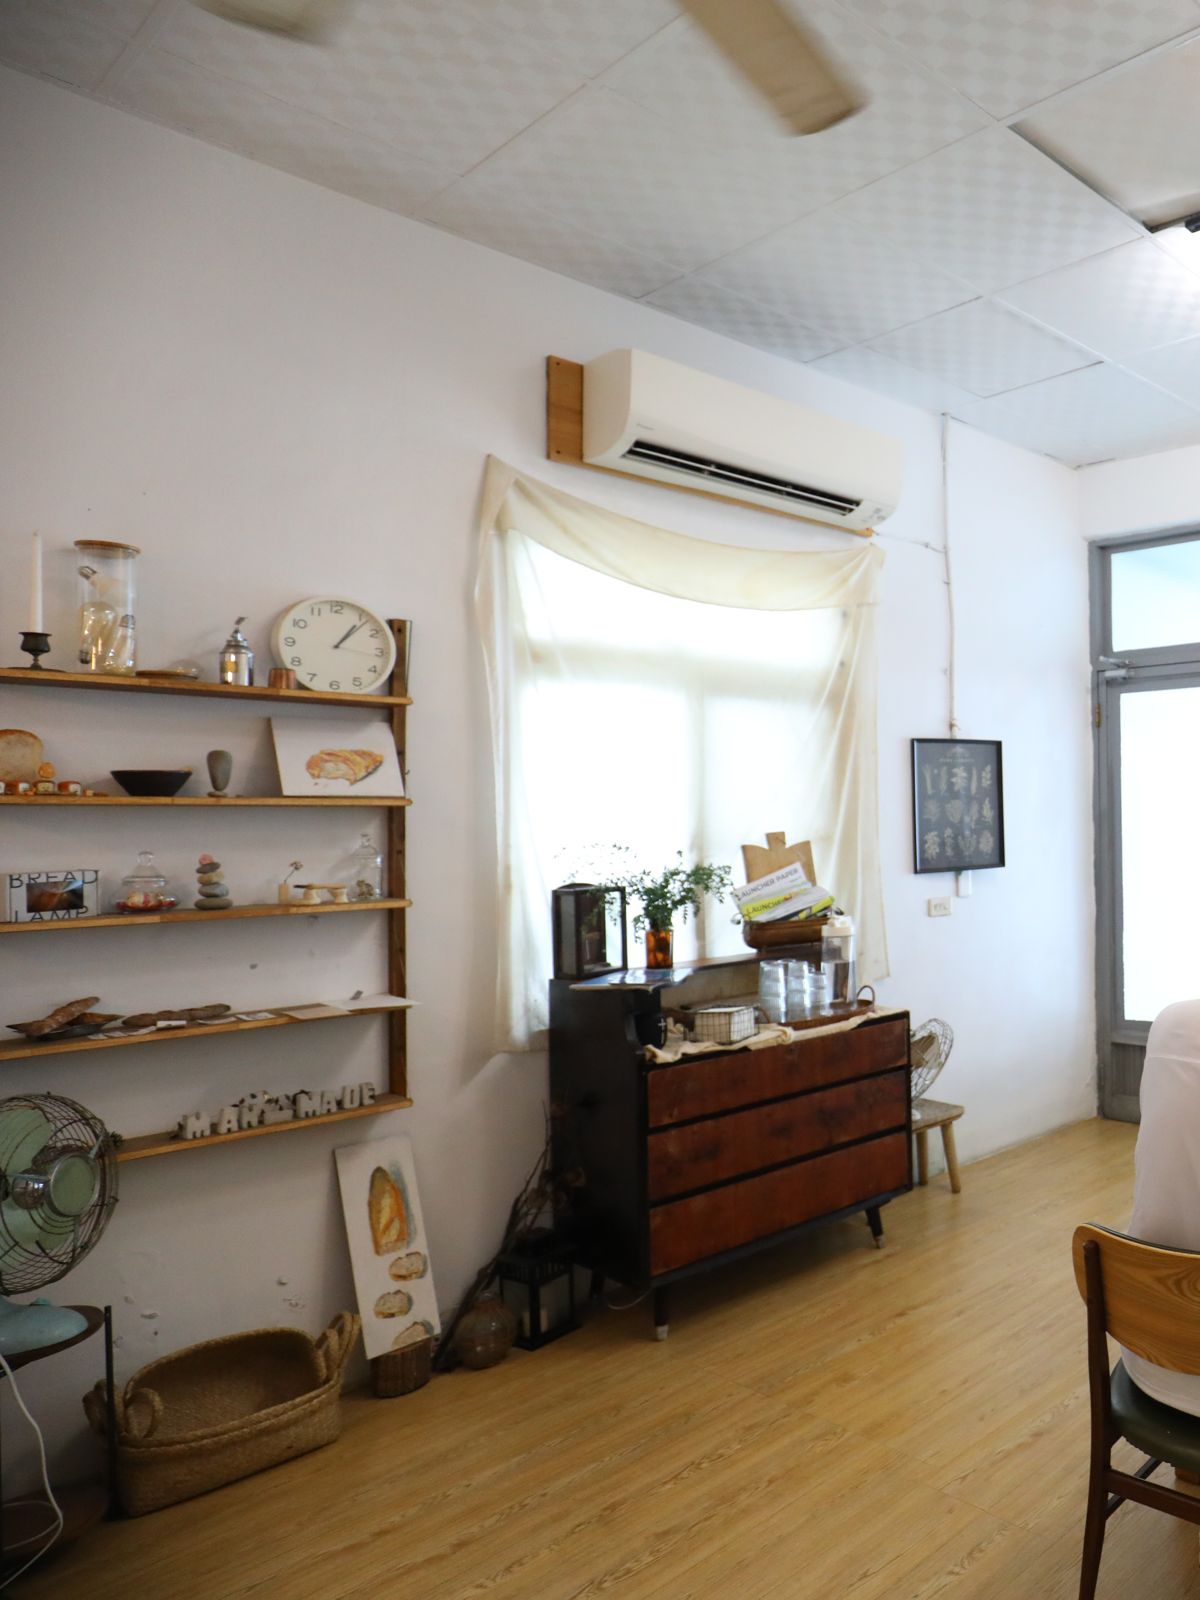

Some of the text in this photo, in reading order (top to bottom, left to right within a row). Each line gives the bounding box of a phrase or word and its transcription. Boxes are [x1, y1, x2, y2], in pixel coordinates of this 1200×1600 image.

[310, 606, 321, 617] 11
[330, 603, 344, 615] 12
[358, 613, 363, 622] 1
[293, 618, 308, 629] 10
[369, 628, 379, 639] 2
[284, 637, 296, 647] 9
[374, 647, 384, 658] 3
[291, 656, 302, 667] 8
[368, 665, 378, 674] 4
[307, 672, 318, 682] 7
[352, 676, 362, 687] 5
[329, 680, 340, 690] 6
[9, 870, 98, 889] BREAD
